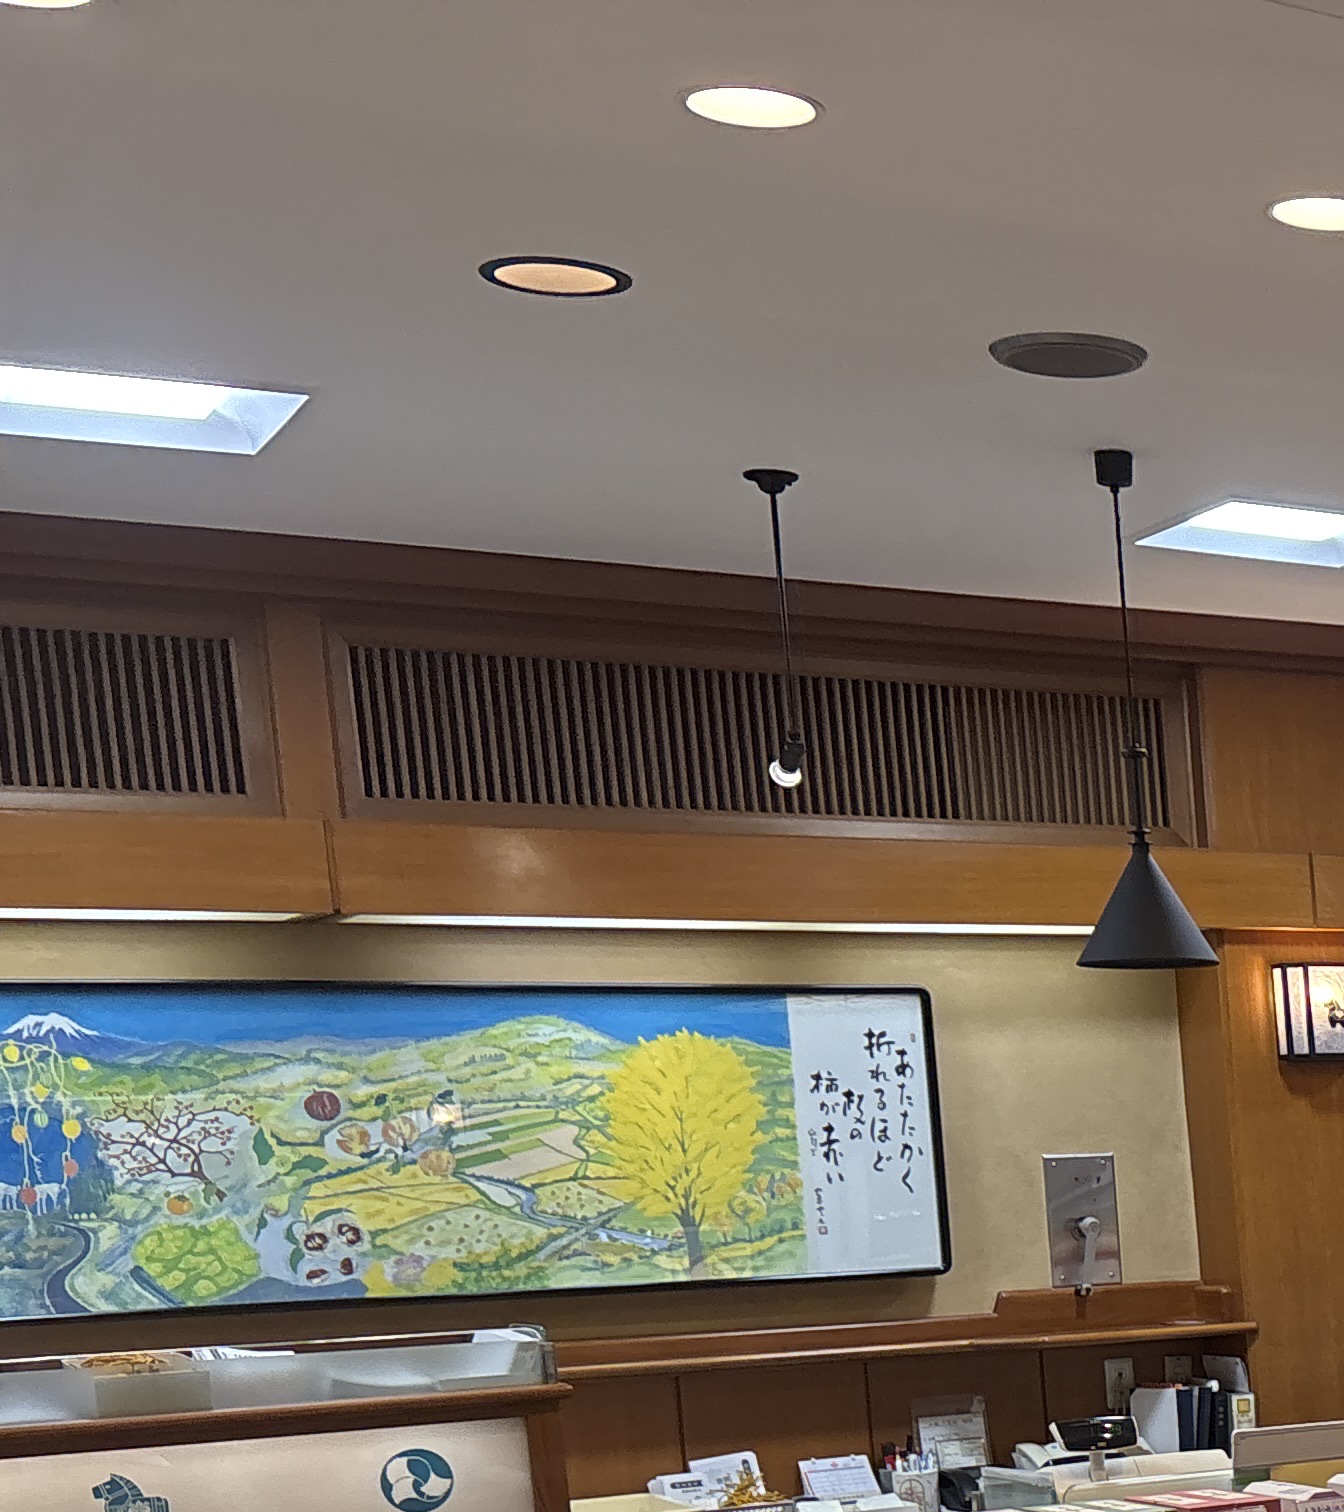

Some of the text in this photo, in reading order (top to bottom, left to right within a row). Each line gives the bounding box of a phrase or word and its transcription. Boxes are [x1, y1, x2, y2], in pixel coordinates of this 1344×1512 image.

[895, 1048, 923, 1193] あたたかく
